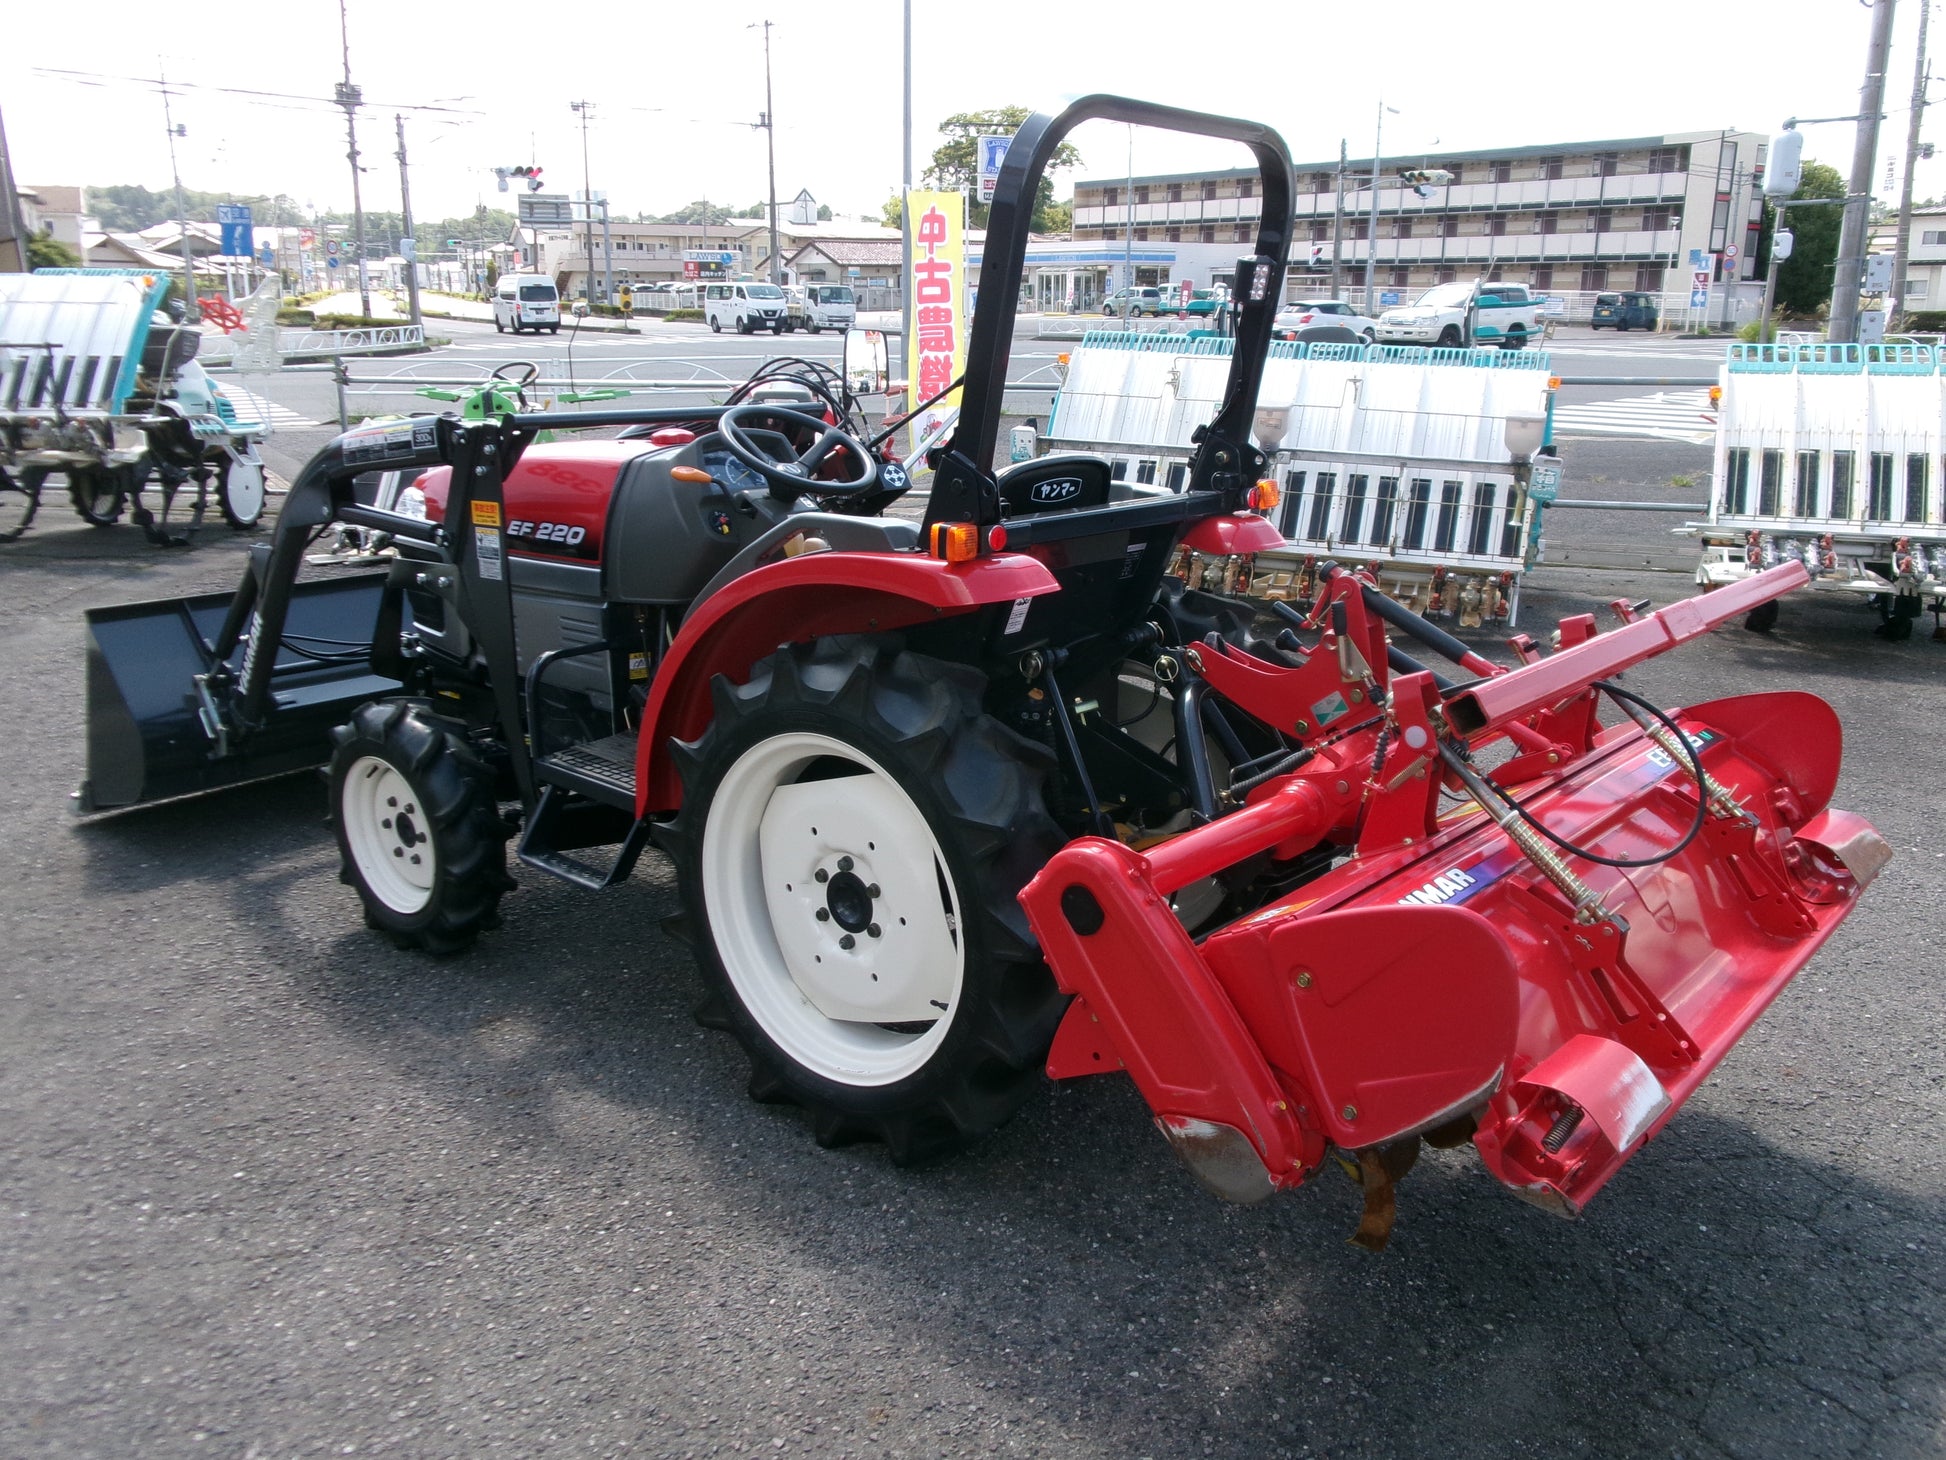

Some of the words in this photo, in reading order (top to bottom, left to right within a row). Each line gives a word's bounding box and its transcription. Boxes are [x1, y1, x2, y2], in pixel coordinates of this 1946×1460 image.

[689, 252, 722, 260] LAWSO
[914, 205, 955, 404] 中古農機
[1041, 482, 1076, 499] ヤンマー
[506, 520, 535, 537] EF
[535, 521, 586, 545] 220
[1397, 867, 1477, 905] NMAR
